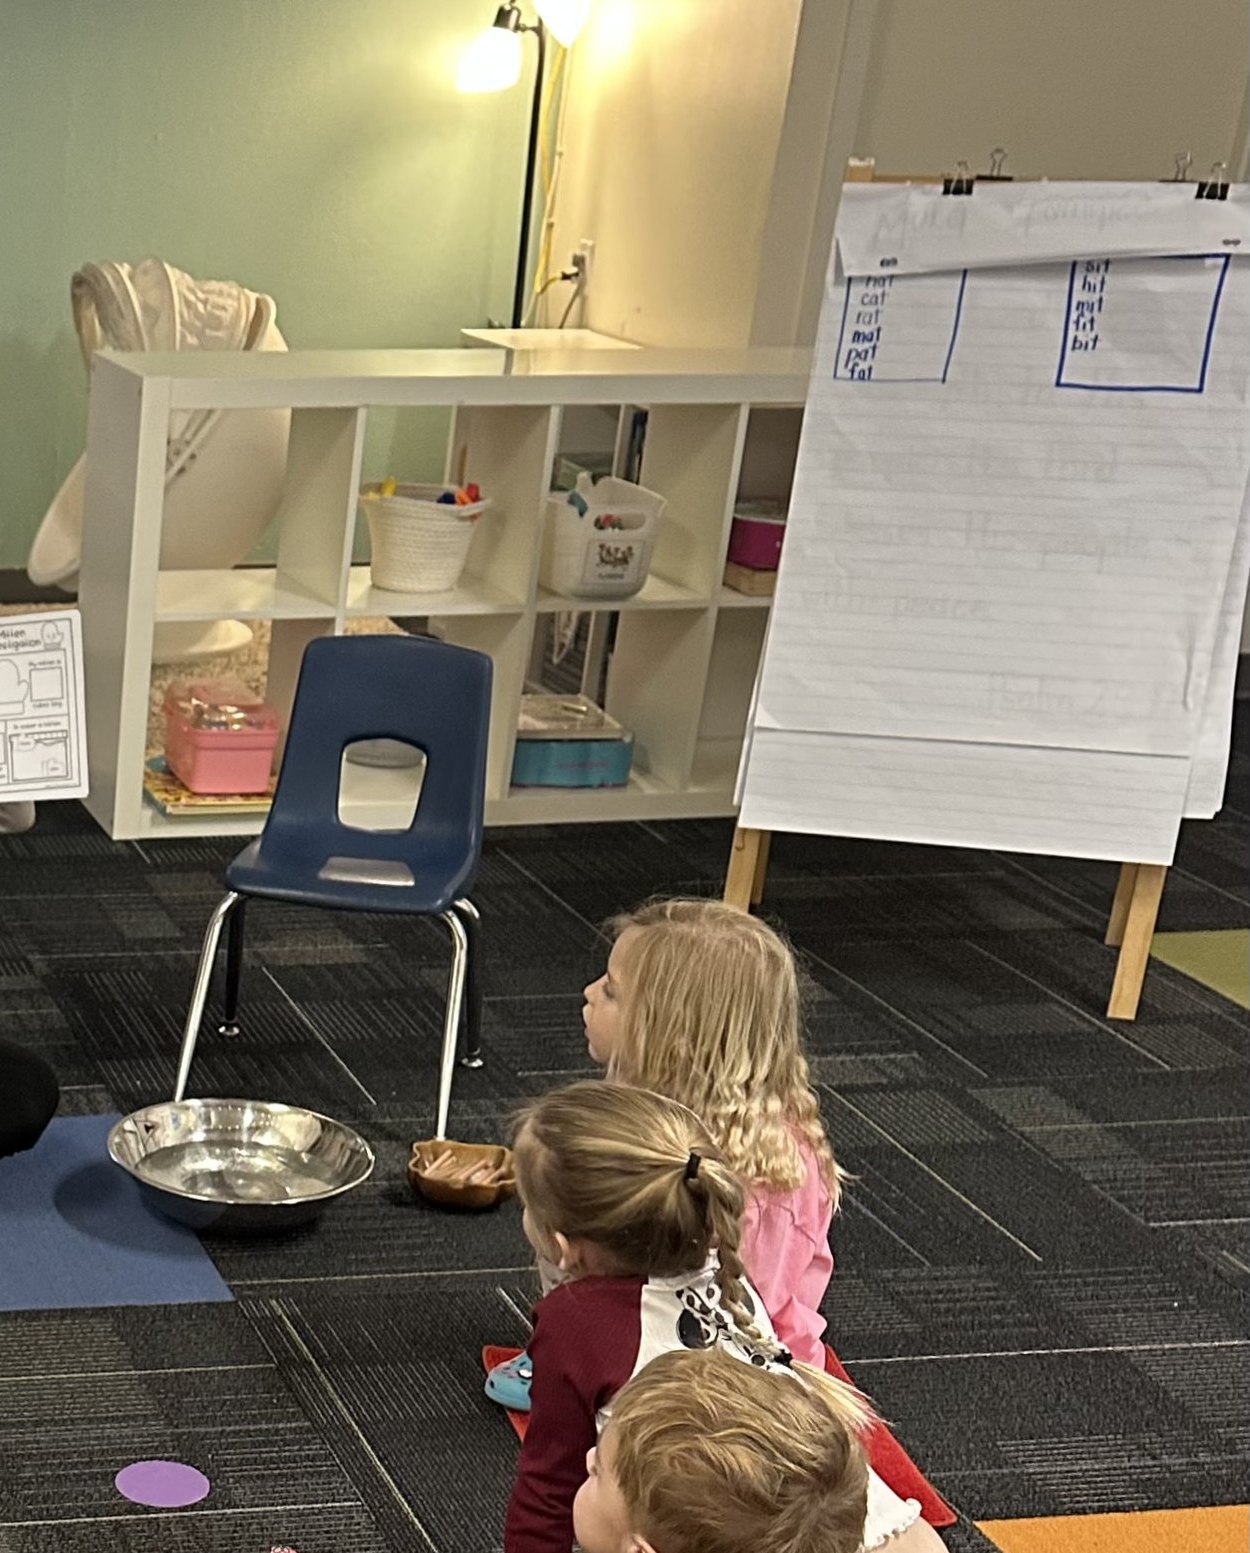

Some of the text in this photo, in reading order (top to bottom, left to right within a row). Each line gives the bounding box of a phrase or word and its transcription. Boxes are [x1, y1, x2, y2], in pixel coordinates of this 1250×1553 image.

[1082, 274, 1106, 294] hit
[861, 290, 886, 306] cat
[856, 308, 880, 325] rat
[852, 326, 881, 344] mat
[1071, 334, 1099, 351] bit
[844, 343, 877, 369] pat
[849, 361, 873, 381] fat
